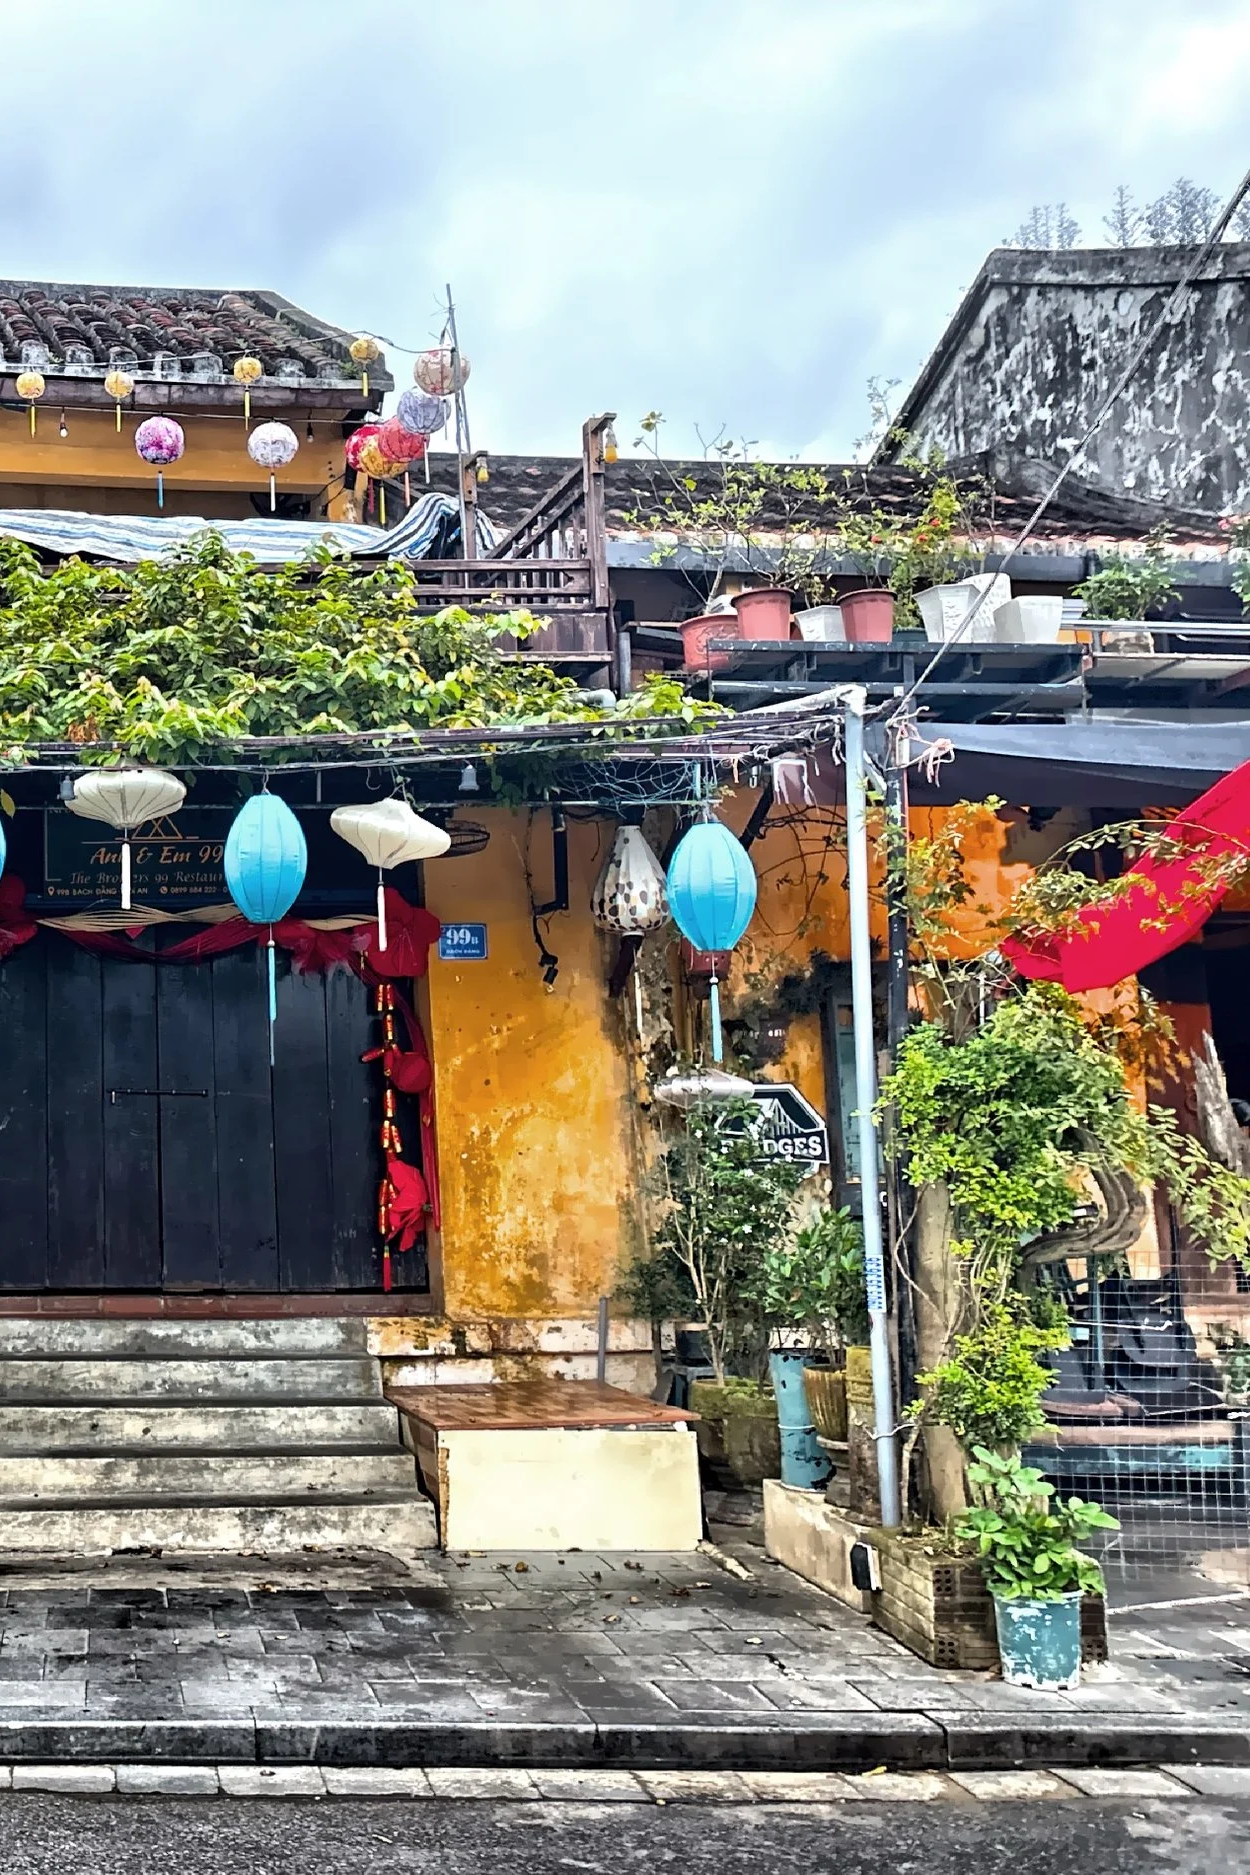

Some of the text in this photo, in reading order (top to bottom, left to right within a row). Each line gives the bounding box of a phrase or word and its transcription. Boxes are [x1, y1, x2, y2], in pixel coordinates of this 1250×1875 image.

[136, 847, 153, 864] &
[159, 846, 192, 864] Em
[199, 845, 224, 864] 99
[70, 872, 91, 884] The
